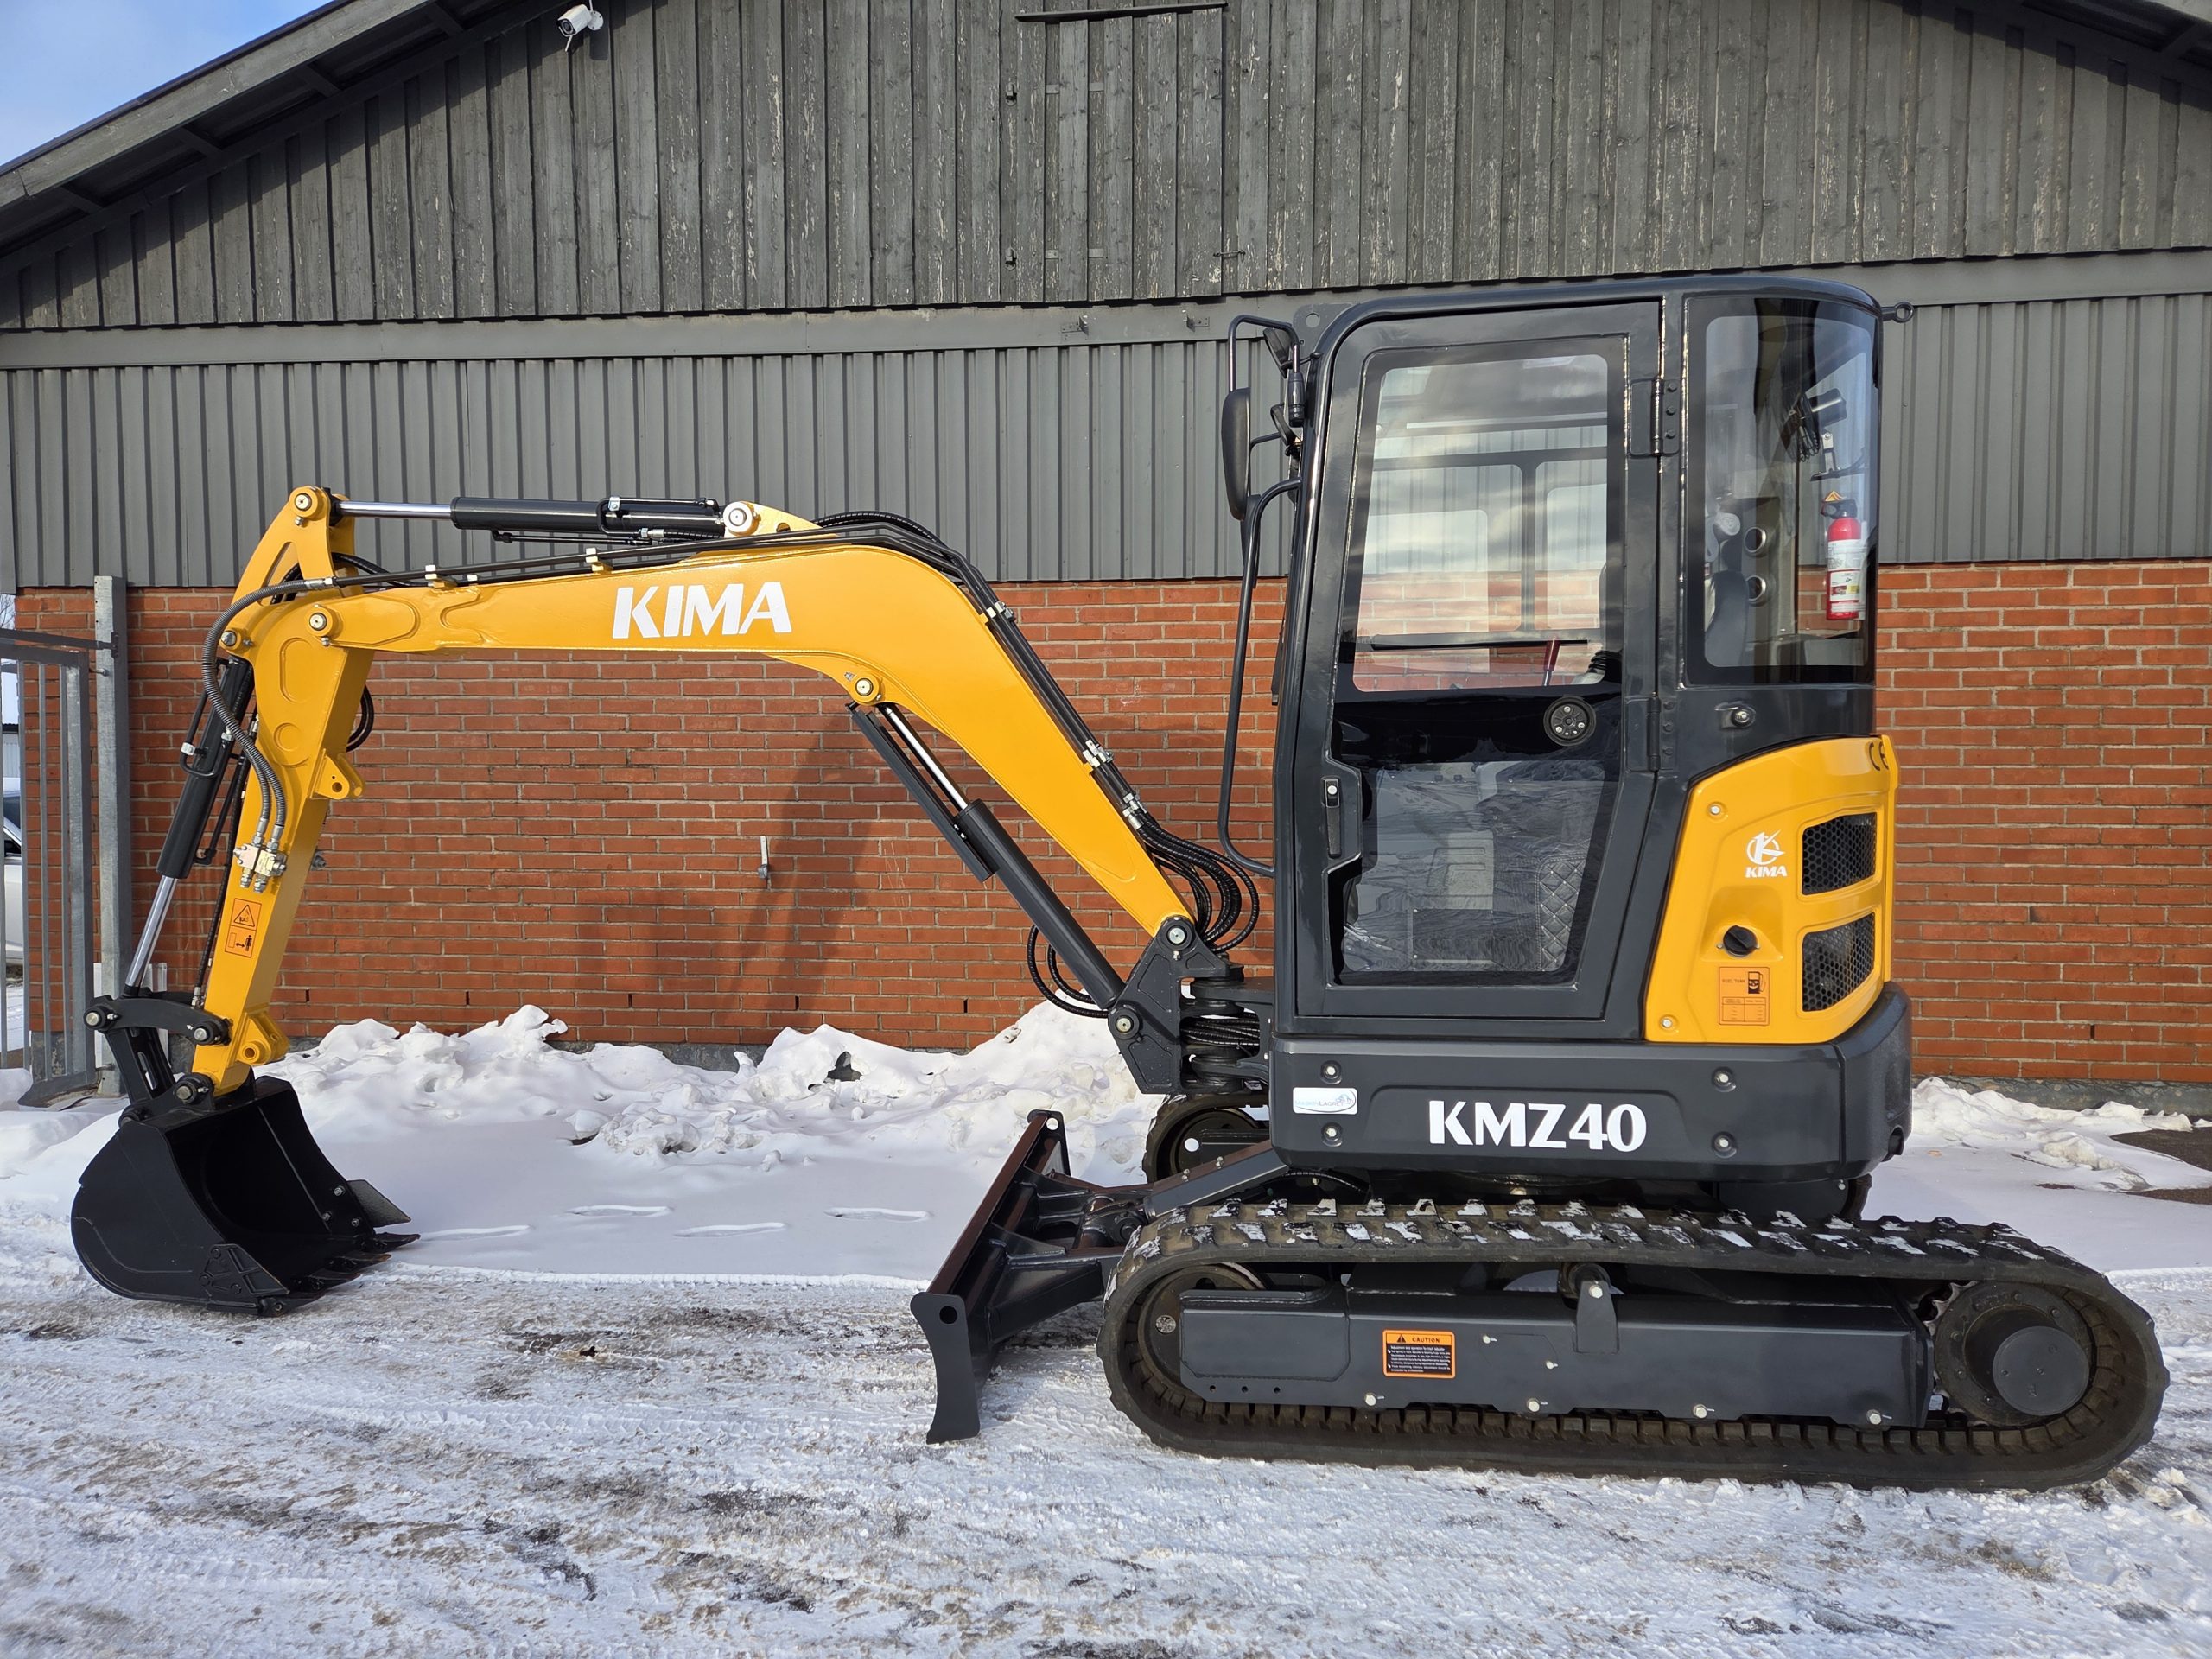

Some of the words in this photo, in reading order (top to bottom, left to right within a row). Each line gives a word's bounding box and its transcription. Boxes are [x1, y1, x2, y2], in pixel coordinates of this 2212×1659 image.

[612, 582, 792, 639] KIMA
[1745, 865, 1788, 878] KIMA
[1428, 1100, 1647, 1153] KMZ40
